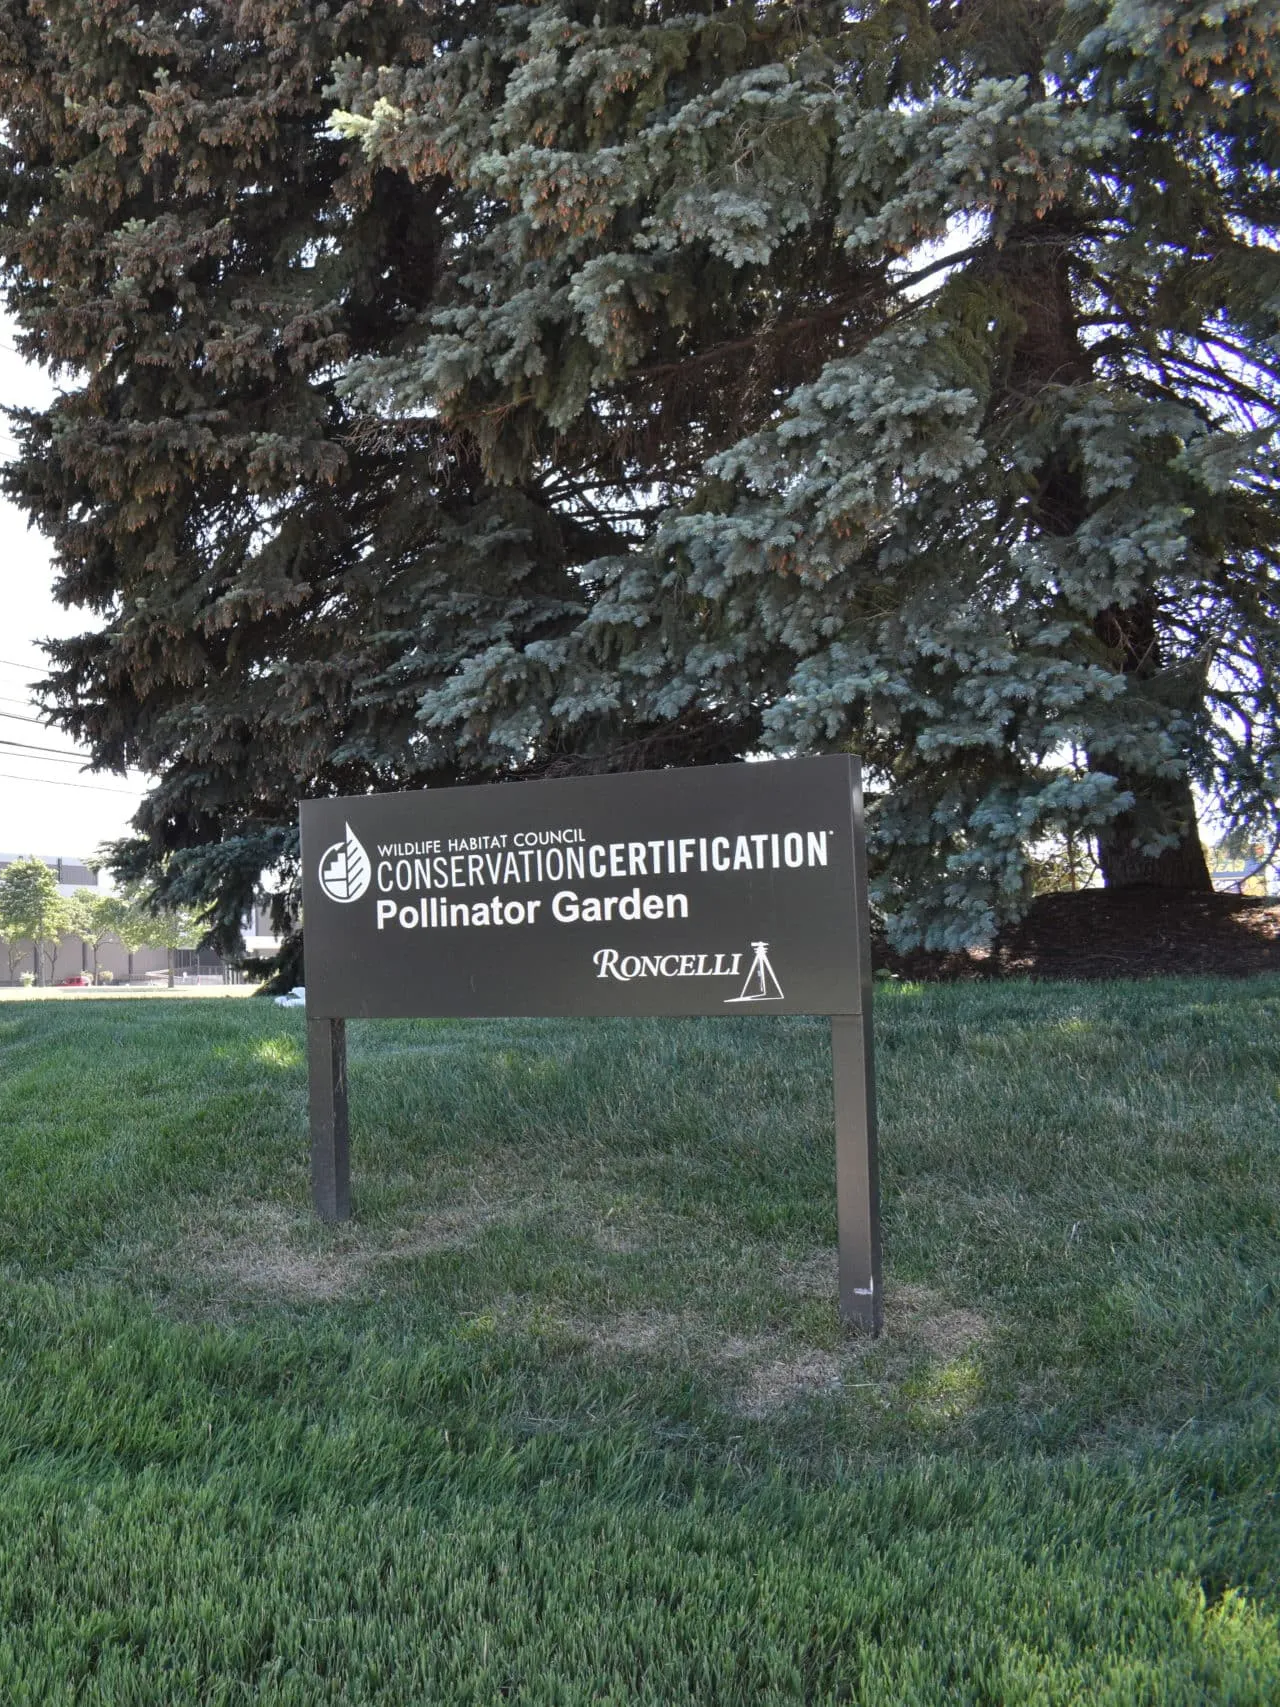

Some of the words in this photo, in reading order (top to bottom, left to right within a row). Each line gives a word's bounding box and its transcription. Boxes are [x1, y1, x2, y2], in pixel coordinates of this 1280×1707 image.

[377, 841, 441, 857] WILDLIFE
[448, 834, 508, 852] HABITAT
[513, 828, 586, 847] COUNCIL
[377, 846, 585, 893] CONSERVATION
[588, 831, 828, 879] CERTIFICATION
[376, 895, 541, 930] Pollinator
[551, 888, 689, 923] Garden
[593, 949, 743, 982] RONCELLI
